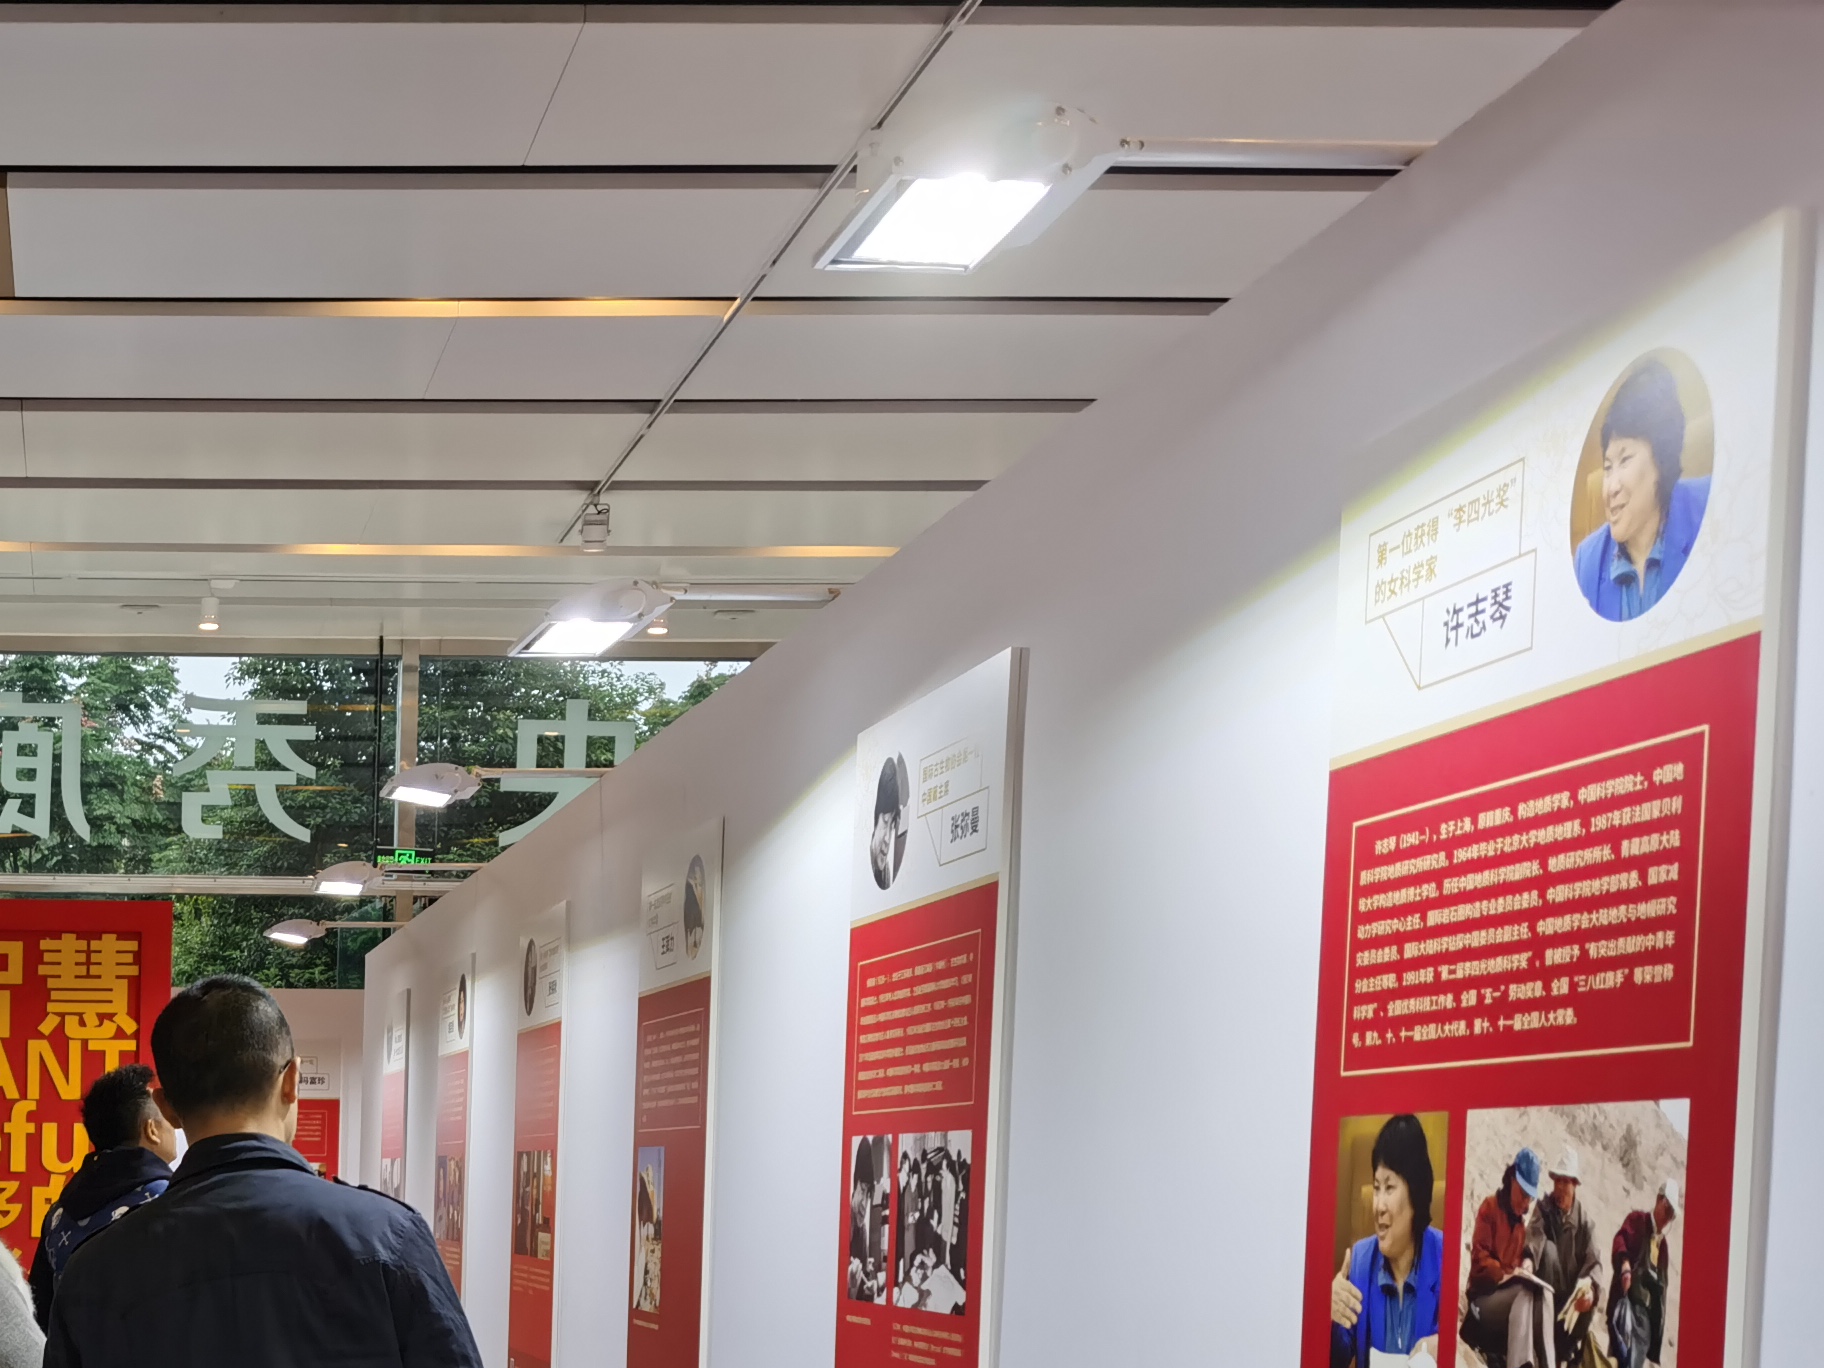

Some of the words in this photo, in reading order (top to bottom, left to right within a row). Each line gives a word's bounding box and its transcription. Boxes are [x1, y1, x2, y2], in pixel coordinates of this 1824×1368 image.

[1375, 476, 1518, 569] 第一位获得“李四光奖”
[1374, 553, 1439, 604] 的女科学家
[1443, 580, 1513, 650] 许志琴
[949, 806, 980, 854] 张弥曼
